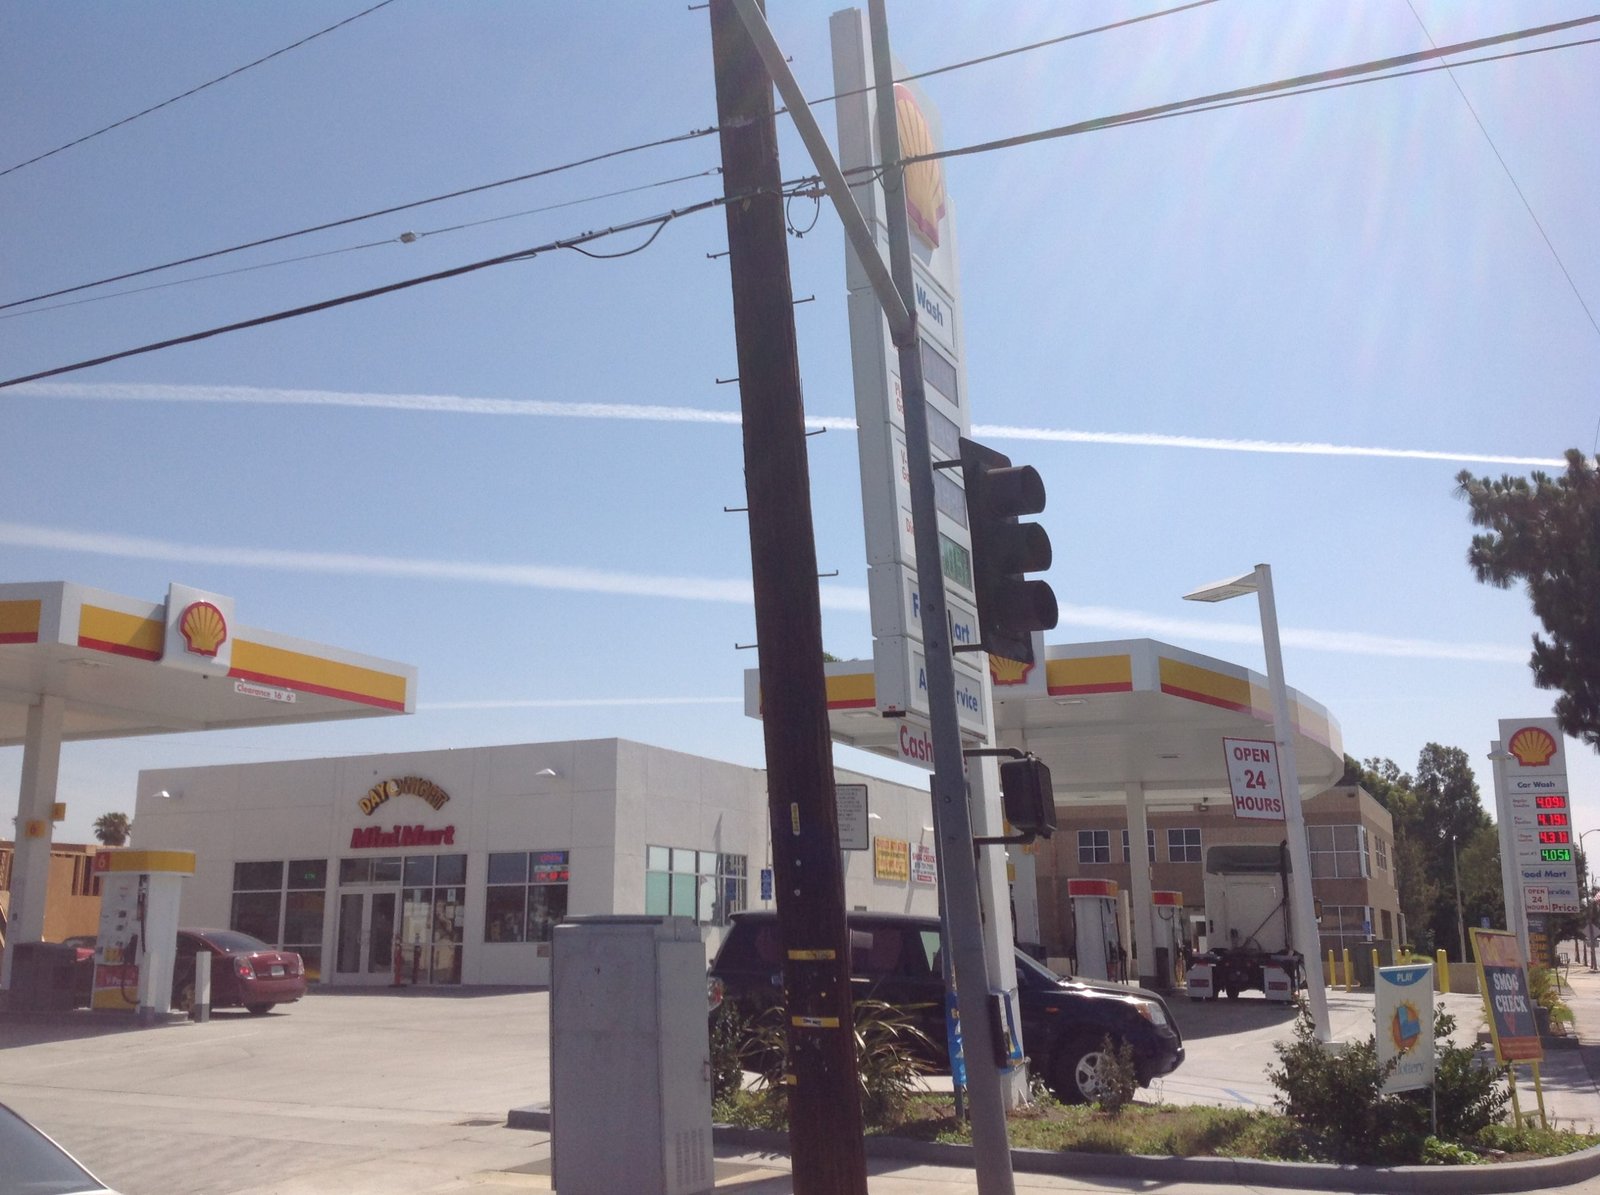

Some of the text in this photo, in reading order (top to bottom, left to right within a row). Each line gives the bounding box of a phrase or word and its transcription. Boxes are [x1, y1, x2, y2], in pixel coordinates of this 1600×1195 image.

[915, 282, 943, 328] Wash
[952, 620, 971, 645] art
[956, 686, 978, 713] rvice
[900, 725, 935, 764] Cash
[1233, 746, 1270, 763] OPEN
[1244, 768, 1266, 790] 24
[1517, 780, 1556, 789] Car Wash
[359, 780, 389, 816] DAY
[1235, 795, 1281, 813] HOURS
[350, 825, 455, 849] Mini Mart
[1544, 869, 1567, 878] Mart
[1526, 902, 1549, 911] HOURS
[1552, 903, 1578, 912] Price
[1396, 973, 1413, 983] PLAY
[1493, 972, 1519, 991] SMOG
[1495, 994, 1528, 1013] CHECK
